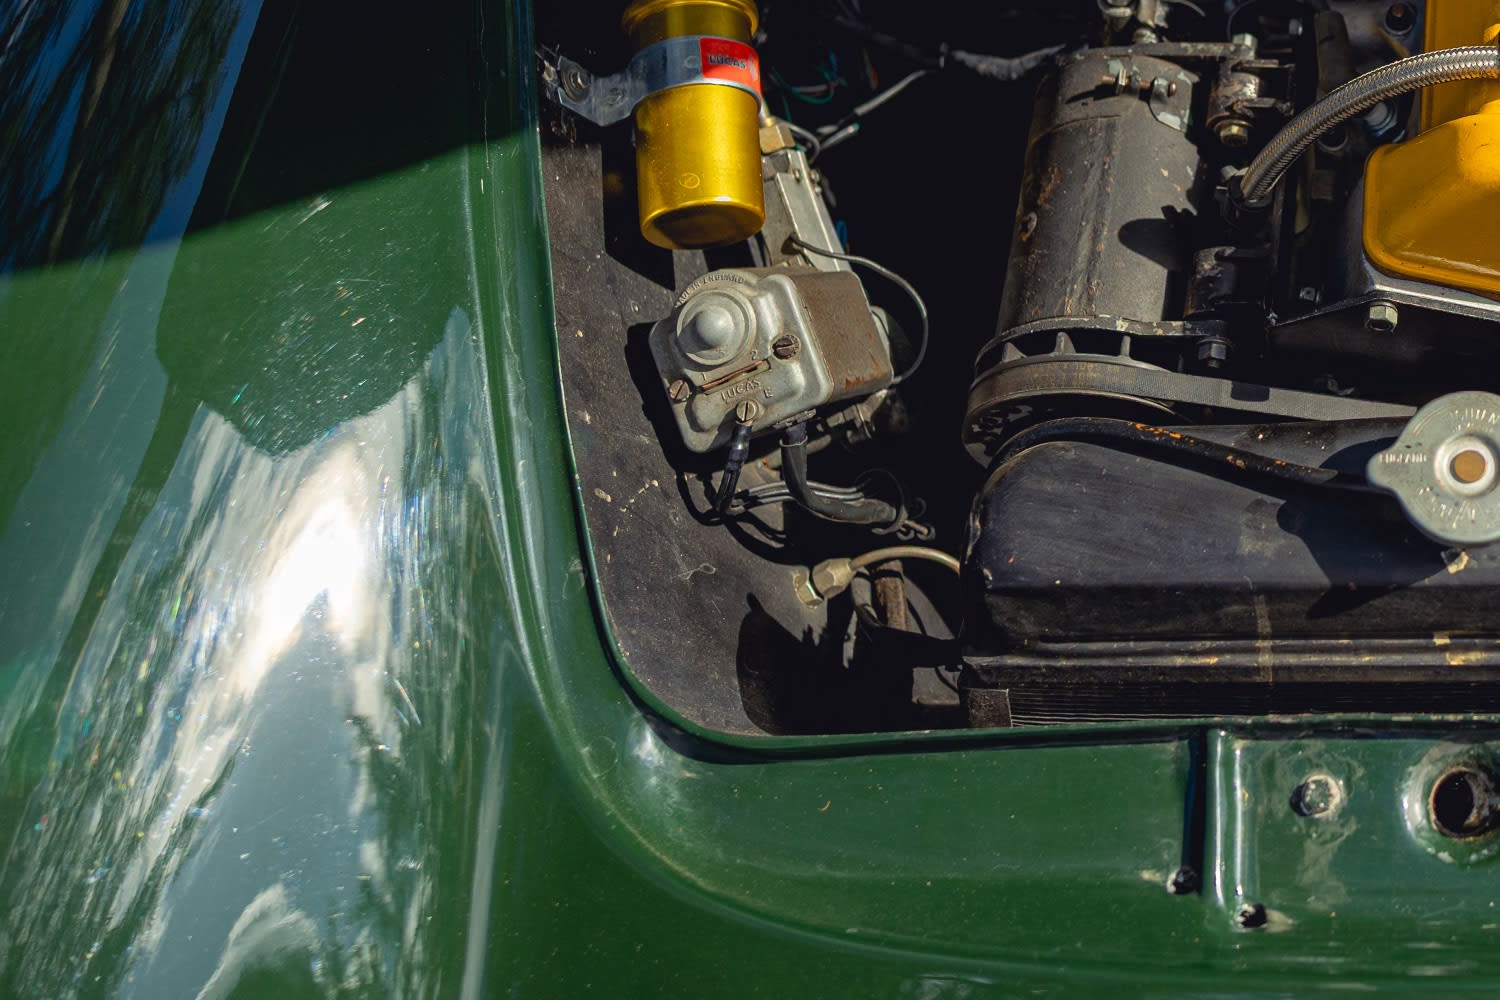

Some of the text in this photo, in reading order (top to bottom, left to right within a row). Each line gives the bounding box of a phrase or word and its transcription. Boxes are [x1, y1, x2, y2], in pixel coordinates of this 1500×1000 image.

[708, 55, 746, 69] LUCAS
[691, 280, 702, 291] IN
[703, 273, 745, 285] ENGLAND
[750, 349, 759, 361] 2
[721, 378, 762, 404] LUCAS
[764, 386, 774, 400] E
